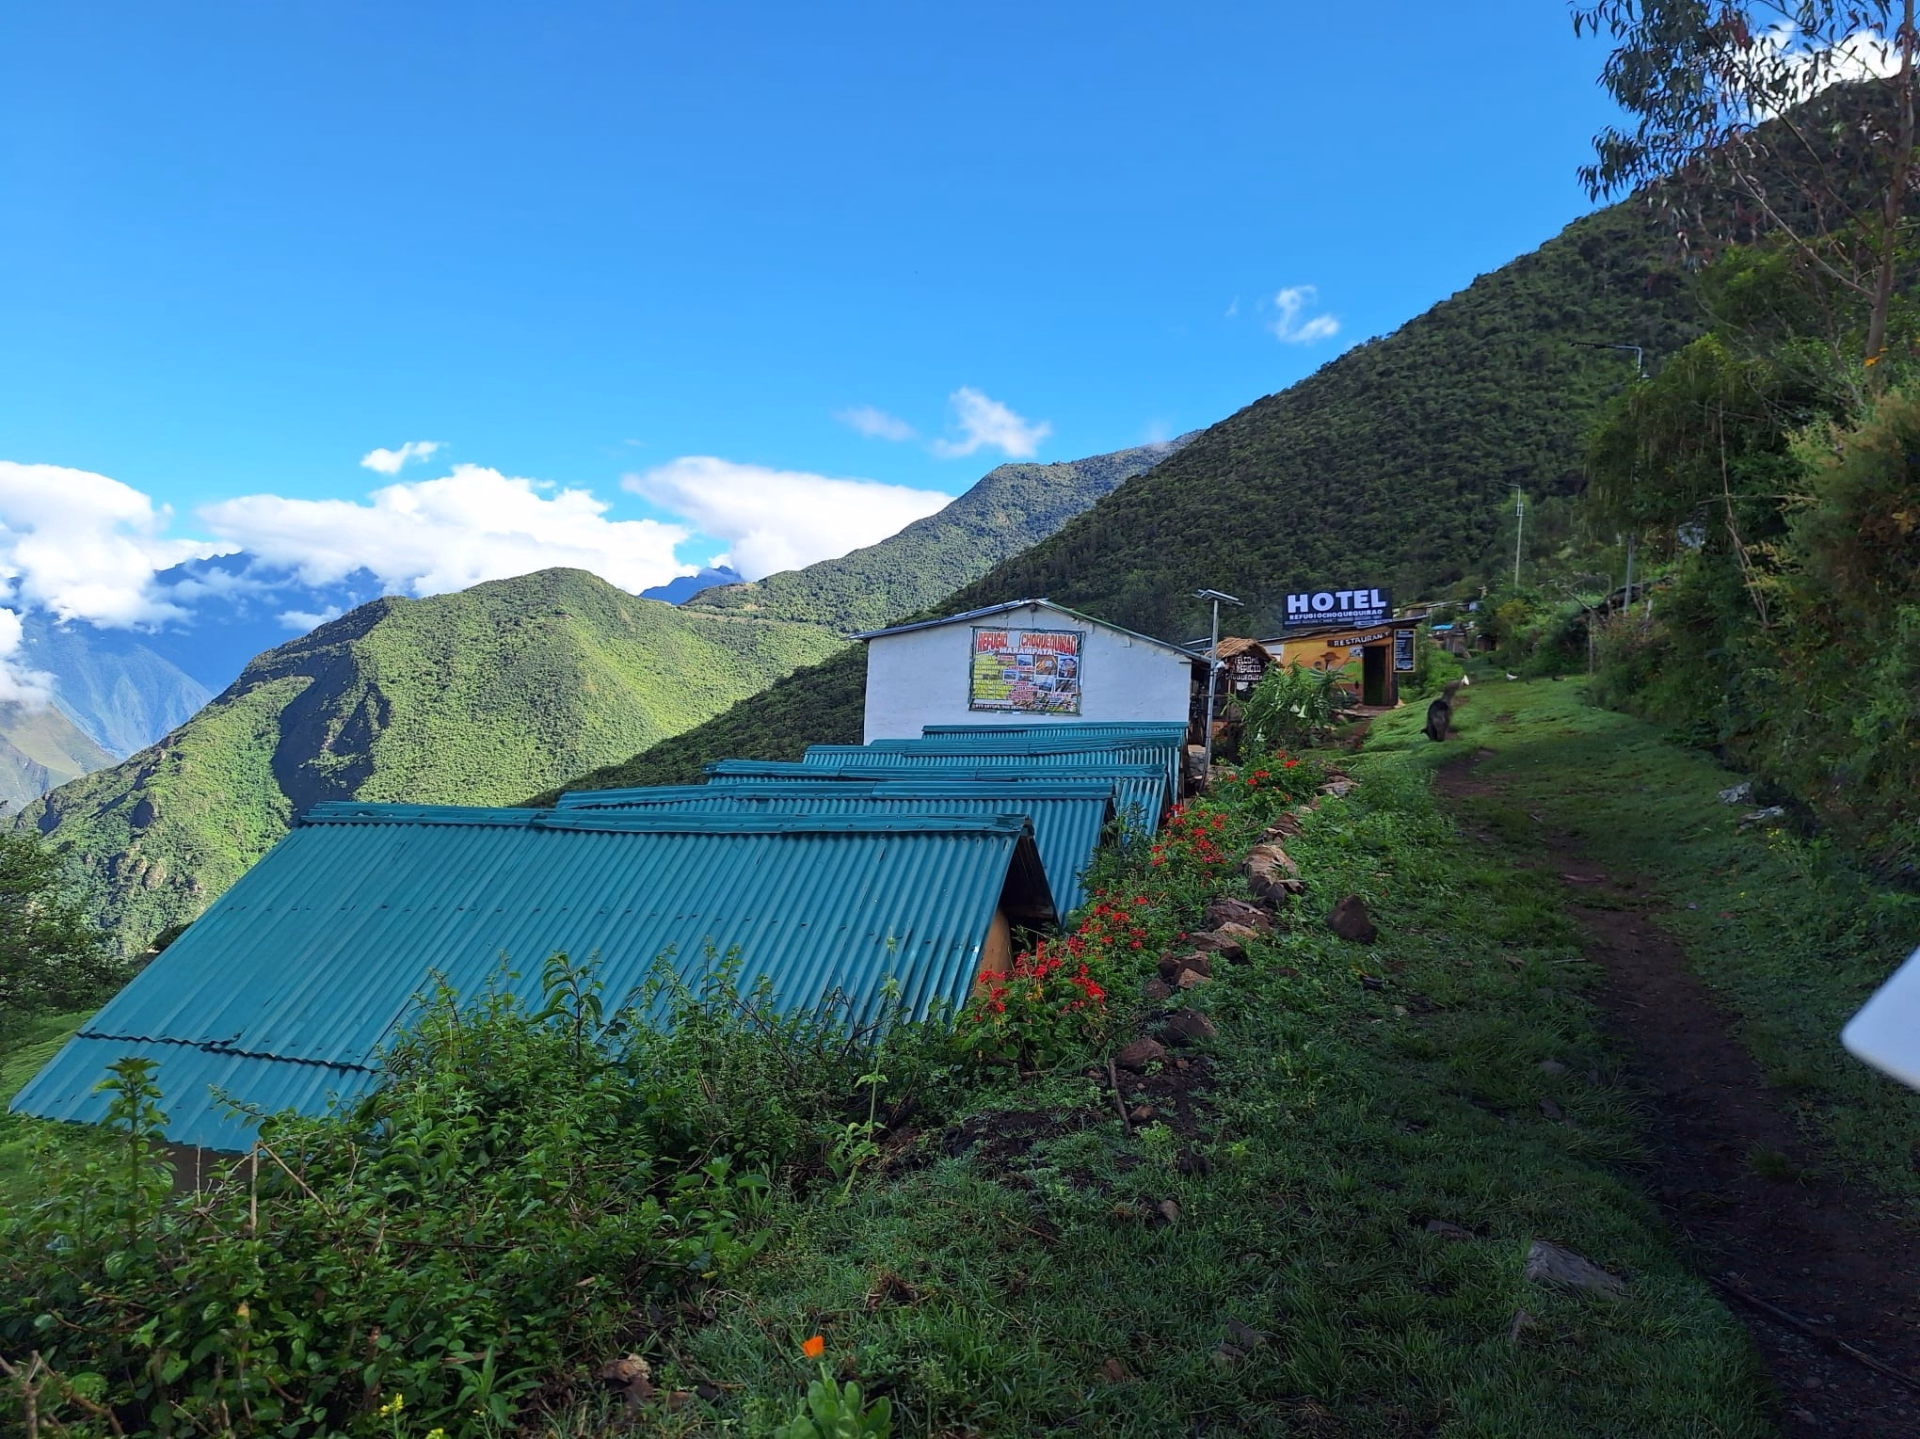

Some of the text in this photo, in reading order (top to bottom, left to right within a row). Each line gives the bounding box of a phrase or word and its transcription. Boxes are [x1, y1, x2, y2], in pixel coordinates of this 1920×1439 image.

[1287, 589, 1386, 613] HOTEL
[1333, 631, 1390, 646] RESTAURANT
[999, 647, 1053, 655] MARAMPATA
